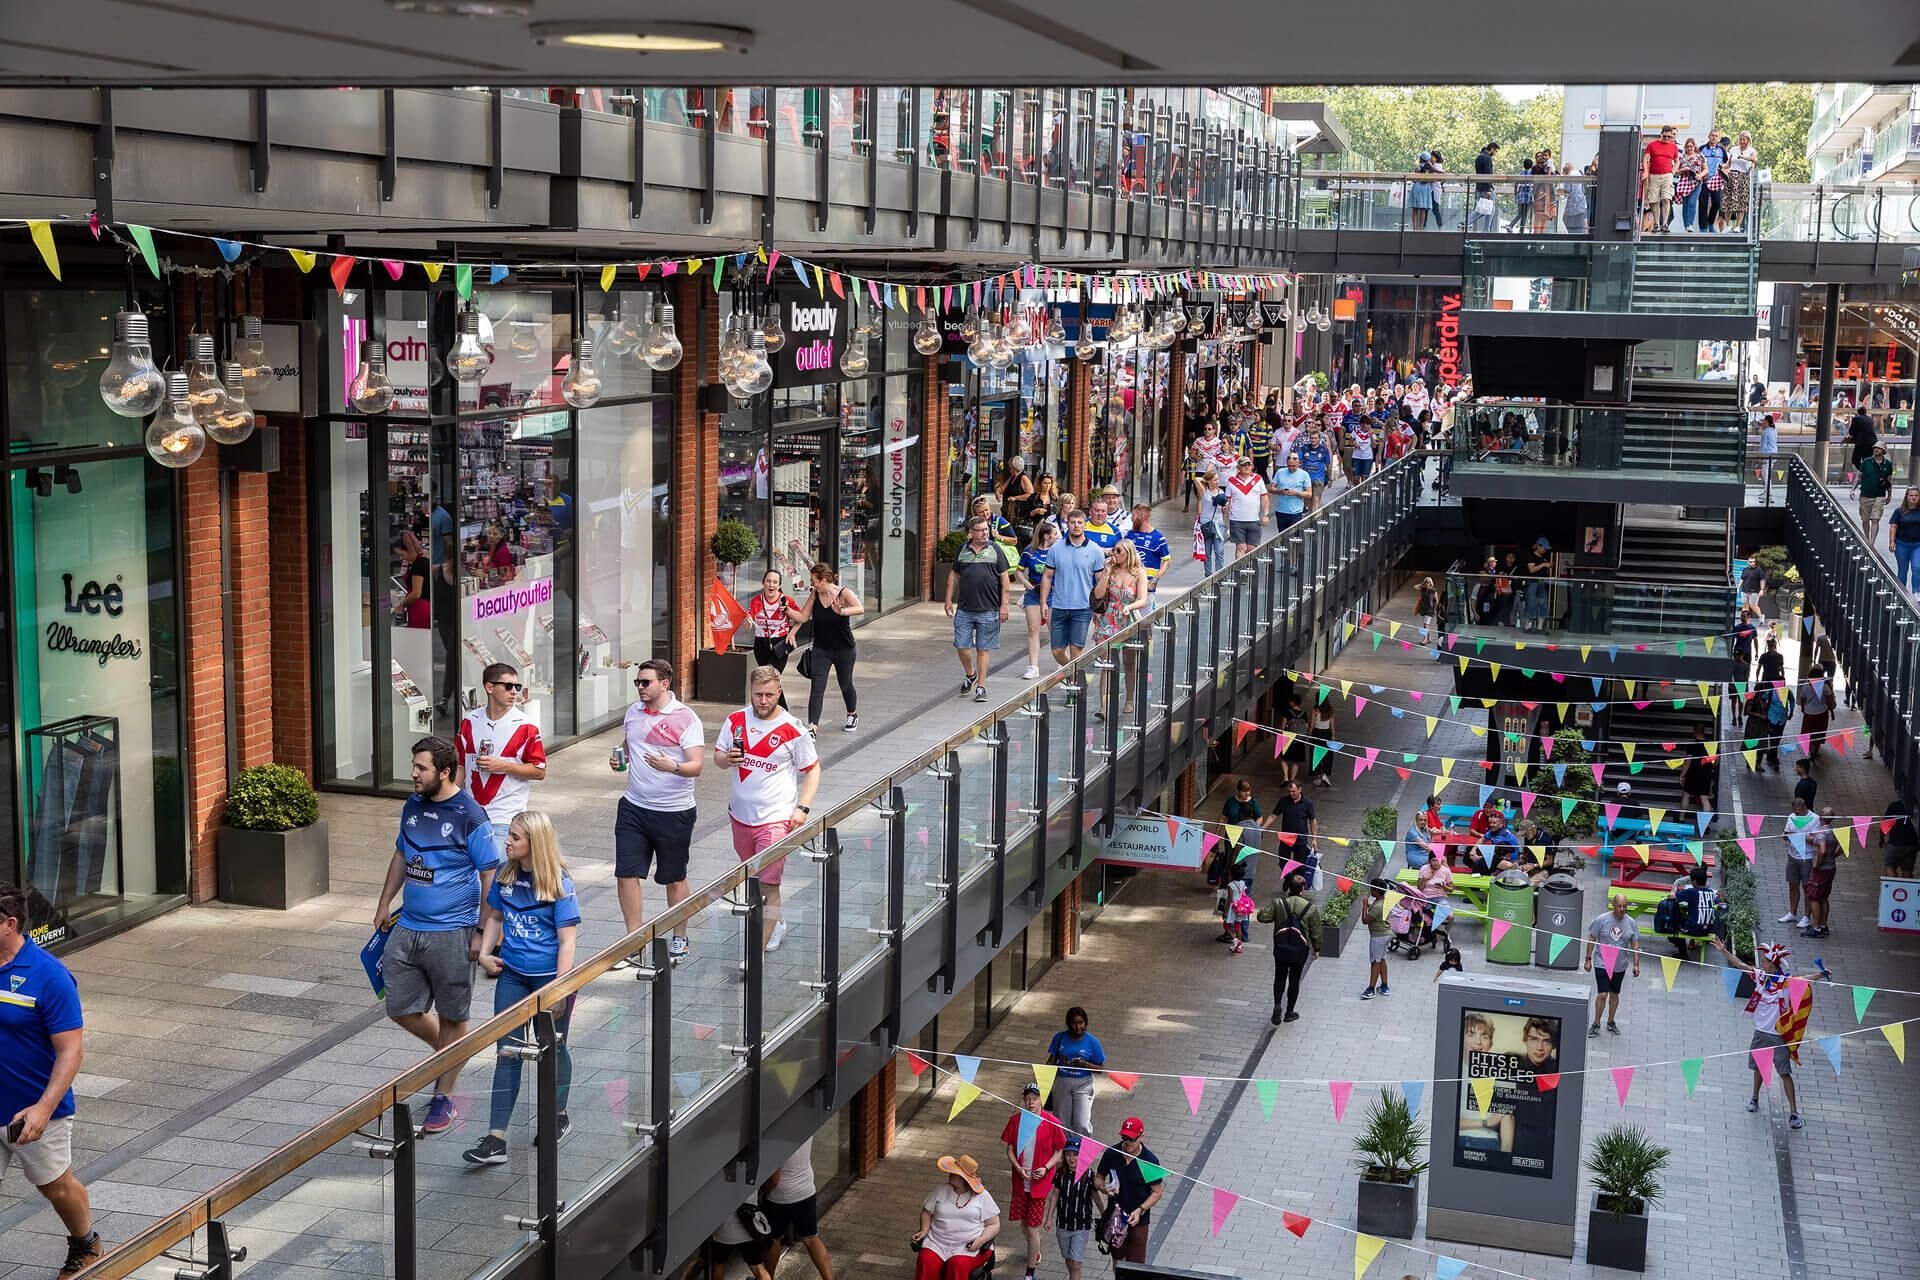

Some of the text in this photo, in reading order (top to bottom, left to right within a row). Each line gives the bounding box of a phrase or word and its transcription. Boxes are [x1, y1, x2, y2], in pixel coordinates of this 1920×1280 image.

[791, 301, 837, 337] beauty
[796, 338, 833, 371] outlet
[889, 436, 905, 538] beautyoutlt
[62, 573, 123, 617] Lee
[477, 580, 552, 620] beautyoutlet
[46, 621, 141, 665] Wrangler
[743, 756, 778, 772] george
[1127, 823, 1160, 833] WORLD
[33, 926, 65, 945] ELIVERY!
[1471, 1052, 1519, 1069] HITS &
[1471, 1064, 1534, 1084] GIGGLES
[1491, 1102, 1516, 1110] HURSDAY
